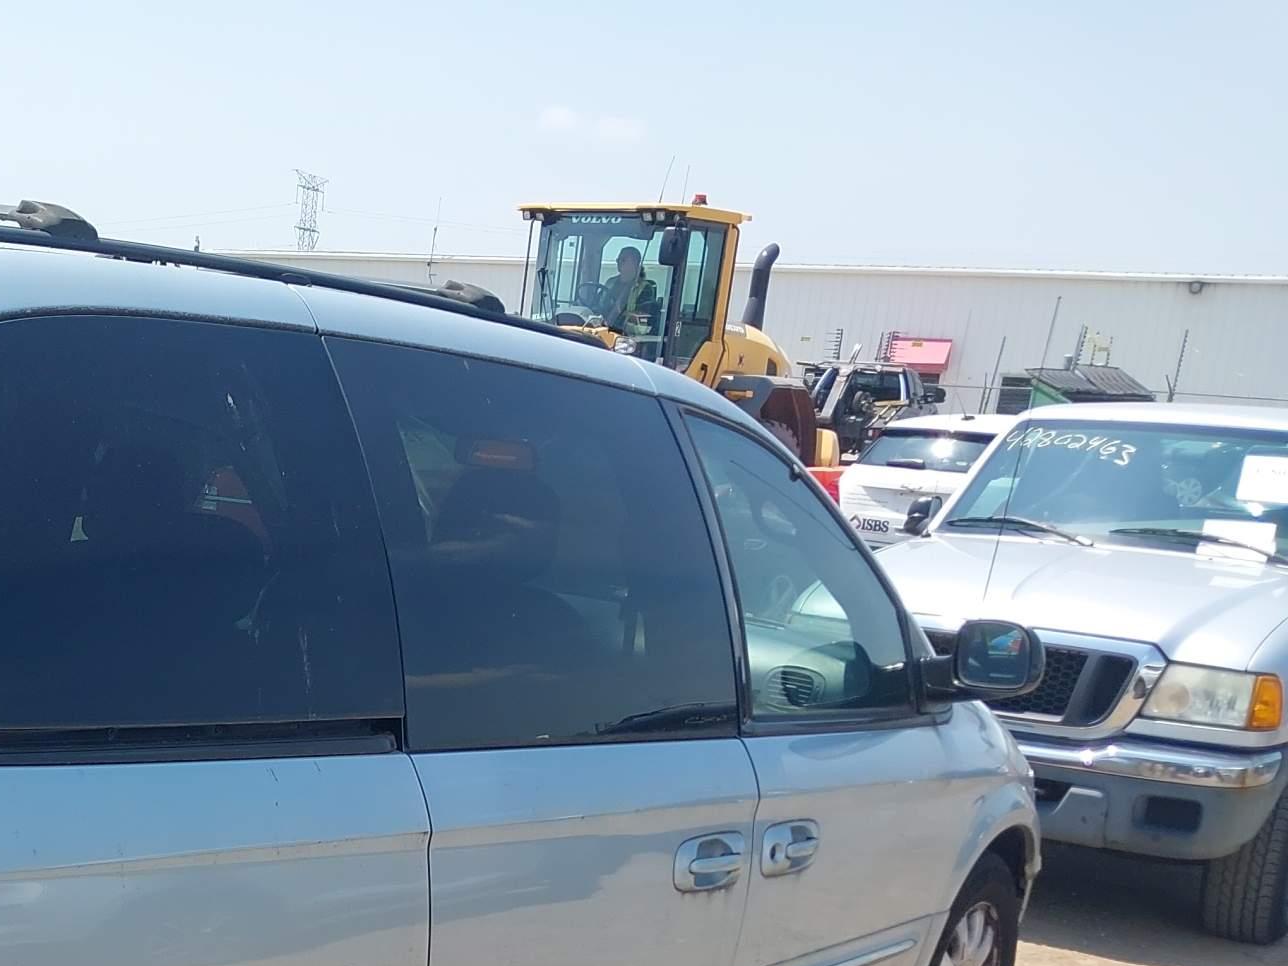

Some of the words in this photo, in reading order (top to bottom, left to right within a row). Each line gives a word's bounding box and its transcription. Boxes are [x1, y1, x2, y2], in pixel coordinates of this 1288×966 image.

[571, 215, 622, 224] VOLVO
[1006, 427, 1137, 466] 42802463
[861, 518, 890, 533] ISBS
